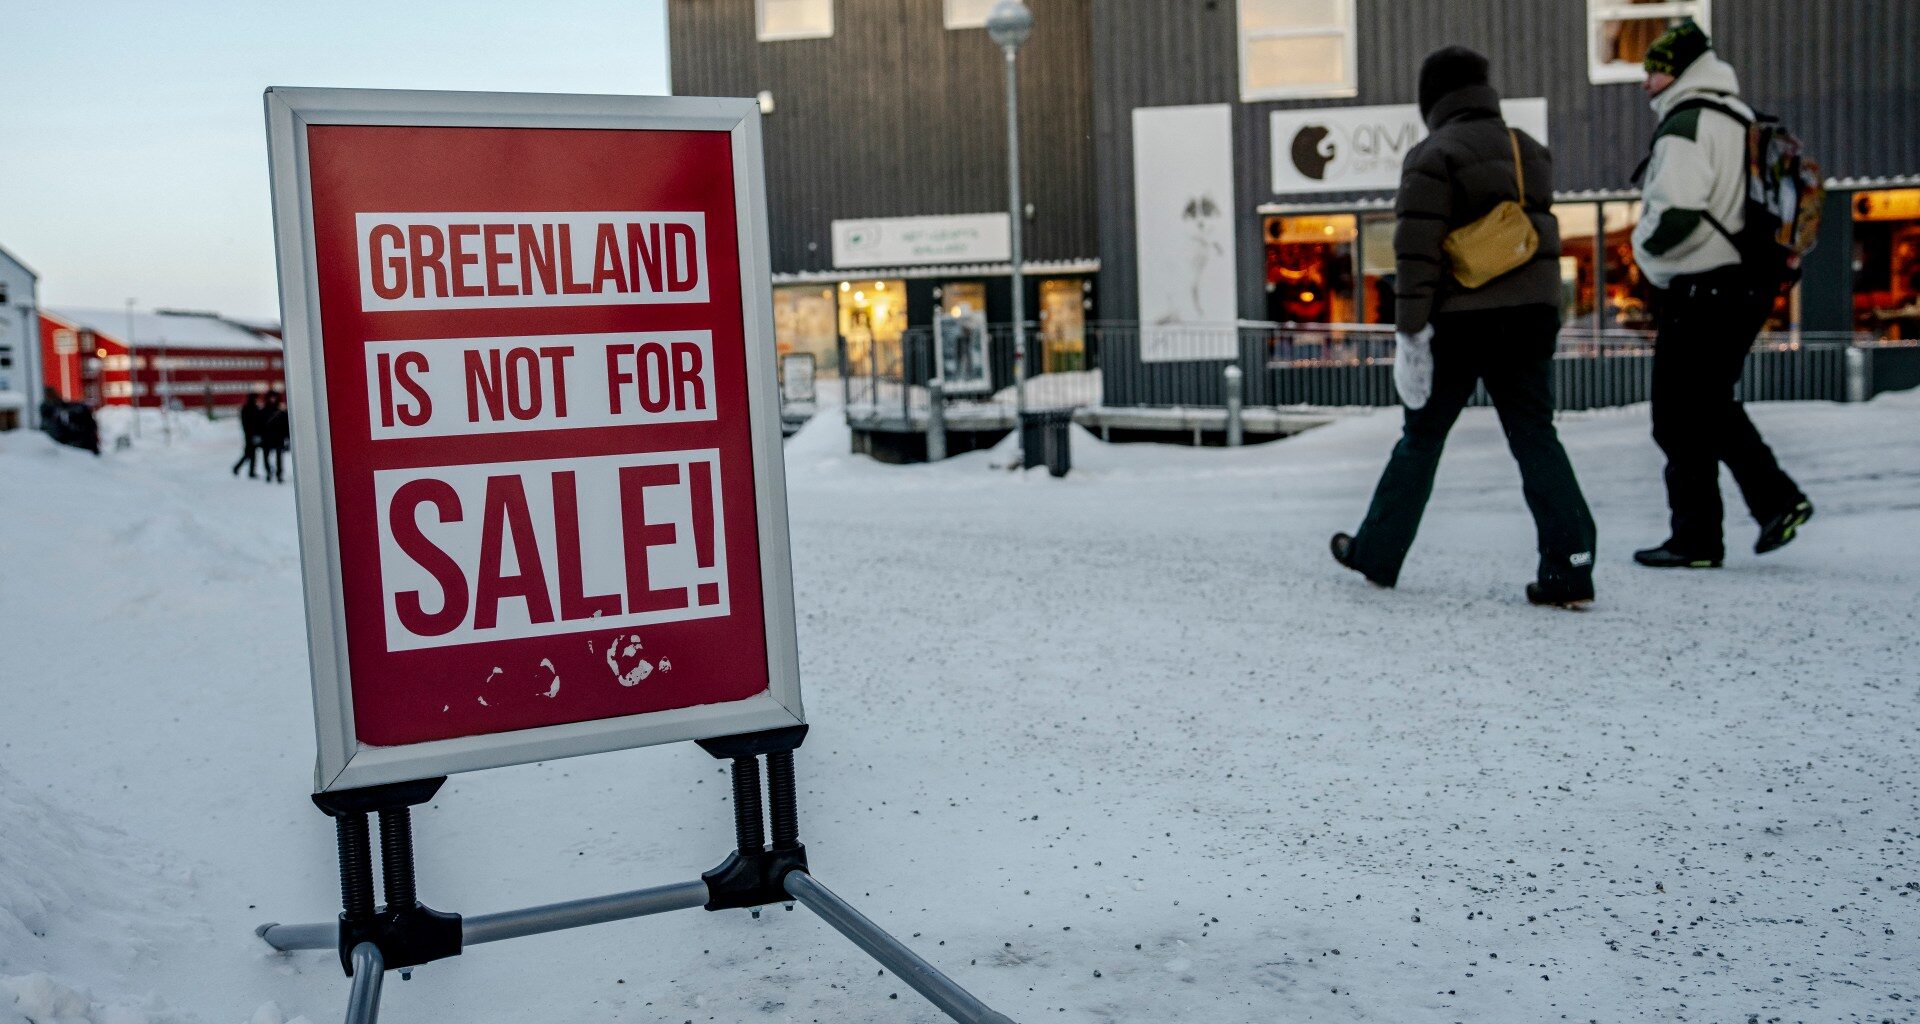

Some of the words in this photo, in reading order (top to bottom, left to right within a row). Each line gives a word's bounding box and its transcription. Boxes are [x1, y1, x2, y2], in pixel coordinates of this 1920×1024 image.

[369, 222, 699, 300] GREENLAND
[377, 351, 433, 428] IS
[463, 346, 574, 423] NOT
[605, 341, 706, 415] FOR
[389, 461, 720, 637] SALE!
